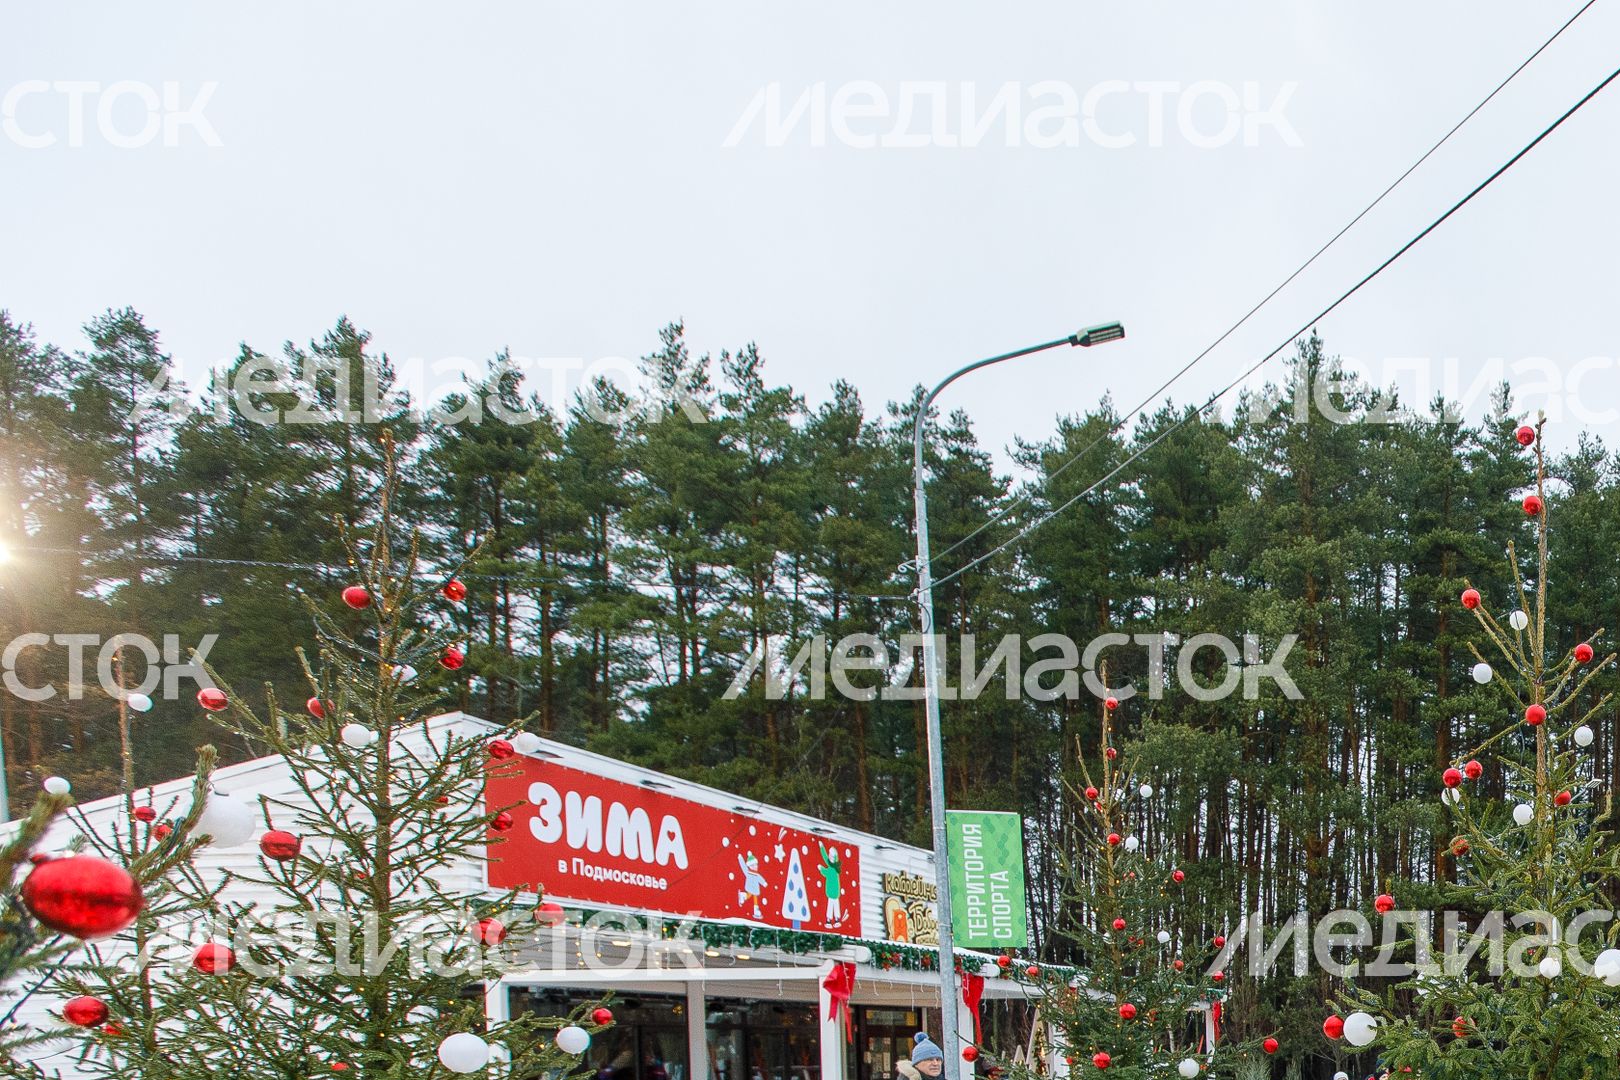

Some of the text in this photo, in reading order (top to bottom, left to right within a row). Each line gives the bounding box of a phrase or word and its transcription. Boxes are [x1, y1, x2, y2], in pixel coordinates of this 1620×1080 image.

[528, 781, 689, 870] ЗИМА
[558, 858, 668, 891] в Подмосковье
[962, 823, 988, 940] ТЕРРИТОРИЯ
[990, 870, 1012, 939] СПОРТА
